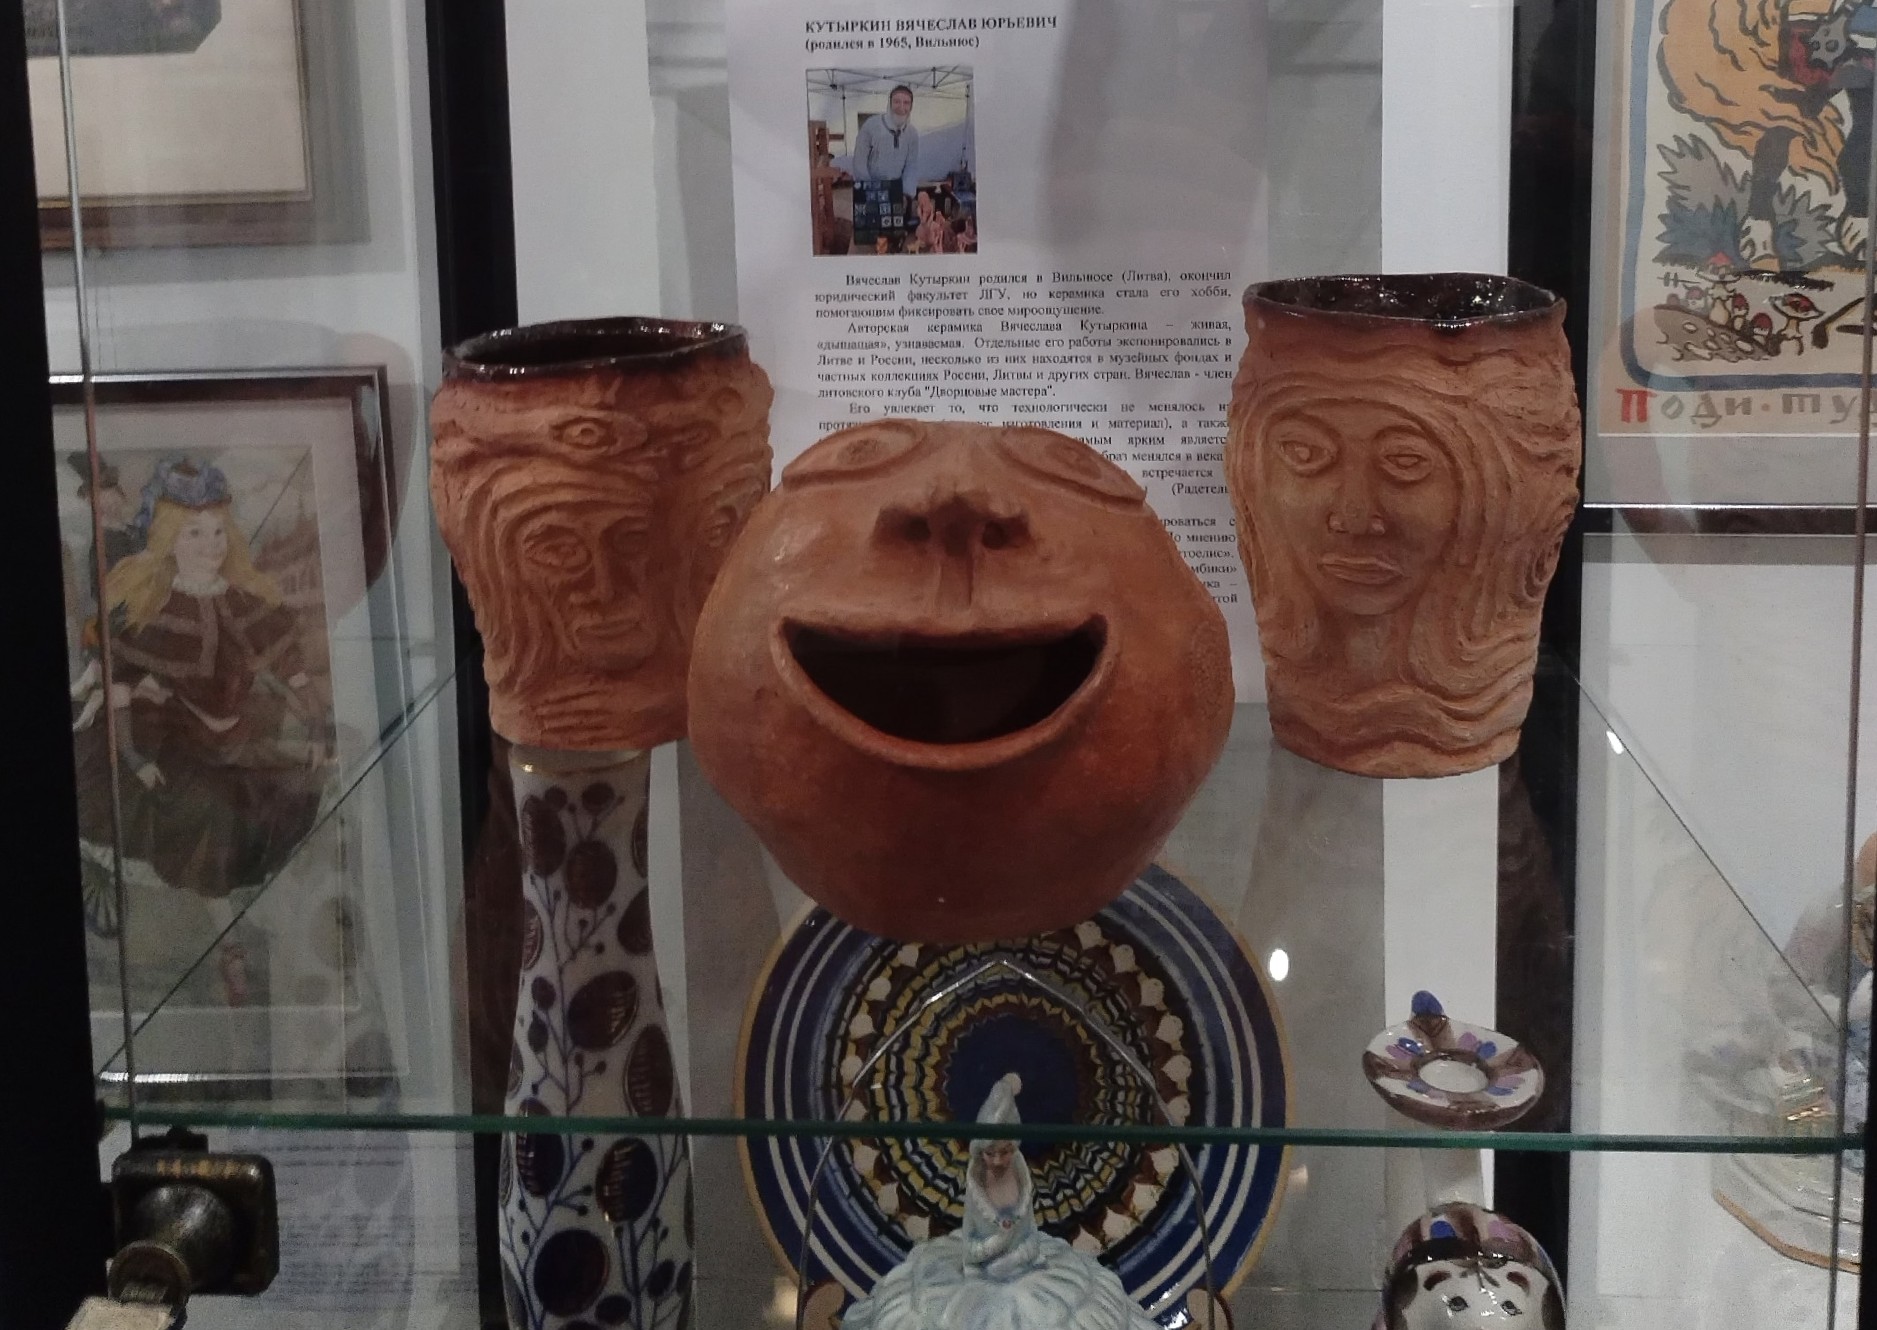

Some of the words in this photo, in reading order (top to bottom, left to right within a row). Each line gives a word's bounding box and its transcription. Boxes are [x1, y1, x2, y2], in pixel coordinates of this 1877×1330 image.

[805, 20, 891, 33] КУТЫРКИН
[897, 18, 977, 32] ВЯЧЕСЛАВ
[982, 16, 1057, 30] ЮРЬЕВИЧ
[805, 38, 863, 53] (родился
[867, 40, 874, 48] в
[916, 37, 980, 49] Вильнюс)
[846, 275, 900, 286] Вячеслав
[910, 274, 970, 286] Кутыркин
[979, 274, 1027, 285] родился
[1037, 274, 1042, 282] в
[1052, 272, 1113, 283] Вильнюсе
[1122, 271, 1170, 284] (Литва),
[1180, 272, 1231, 280] окончил
[815, 291, 895, 303] юридический
[908, 290, 968, 303] факультет
[1049, 289, 1104, 298] керамика
[1116, 289, 1148, 297] стала
[1161, 289, 1179, 297] его
[816, 309, 894, 318] помогающим
[899, 306, 974, 319] фиксировать
[978, 307, 1003, 315] свое
[848, 324, 909, 335] Авторская
[928, 323, 983, 333] керамика
[1001, 322, 1062, 332] Вячеслава
[1081, 320, 1147, 333] Кутыркина
[1191, 321, 1231, 331] живая,
[895, 340, 964, 351] узнаваемая.
[975, 338, 1040, 348] Отдельные
[1045, 339, 1064, 347] его
[1069, 336, 1112, 348] работы
[1117, 337, 1220, 348] экспонировались
[817, 355, 852, 366] Литве
[858, 357, 865, 365] и
[871, 355, 915, 366] России,
[921, 355, 981, 365] несколько
[987, 356, 999, 364] из
[1005, 355, 1026, 364] них
[1032, 354, 1092, 364] находятся
[1098, 355, 1103, 363] в
[1110, 352, 1168, 365] музейных
[1175, 352, 1218, 365] фондах
[818, 372, 865, 381] частных
[871, 371, 938, 381] коллекциях
[944, 370, 988, 381] России,
[992, 369, 1032, 380] Литвы
[1037, 370, 1043, 379] и
[1048, 370, 1089, 382] других
[1094, 370, 1130, 381] стран.
[1135, 369, 1190, 379] Вячеслав
[1204, 370, 1232, 378] член
[818, 389, 884, 398] литовского
[888, 386, 921, 399] клуба
[925, 386, 997, 399] "Дворцовые
[850, 403, 870, 413] Его
[884, 404, 935, 415] увлекает
[949, 404, 965, 414] то,
[979, 404, 998, 413] что
[1012, 404, 1108, 413] технологически
[1121, 403, 1135, 412] не
[1149, 403, 1205, 412] менялось
[1092, 420, 1098, 429] и
[1198, 419, 1228, 429] такж
[1128, 436, 1164, 447] ярким
[1132, 452, 1181, 462] менялся
[1186, 453, 1192, 461] в
[1142, 468, 1213, 480] встречается
[1229, 518, 1236, 526] с
[1186, 534, 1235, 543] мнению
